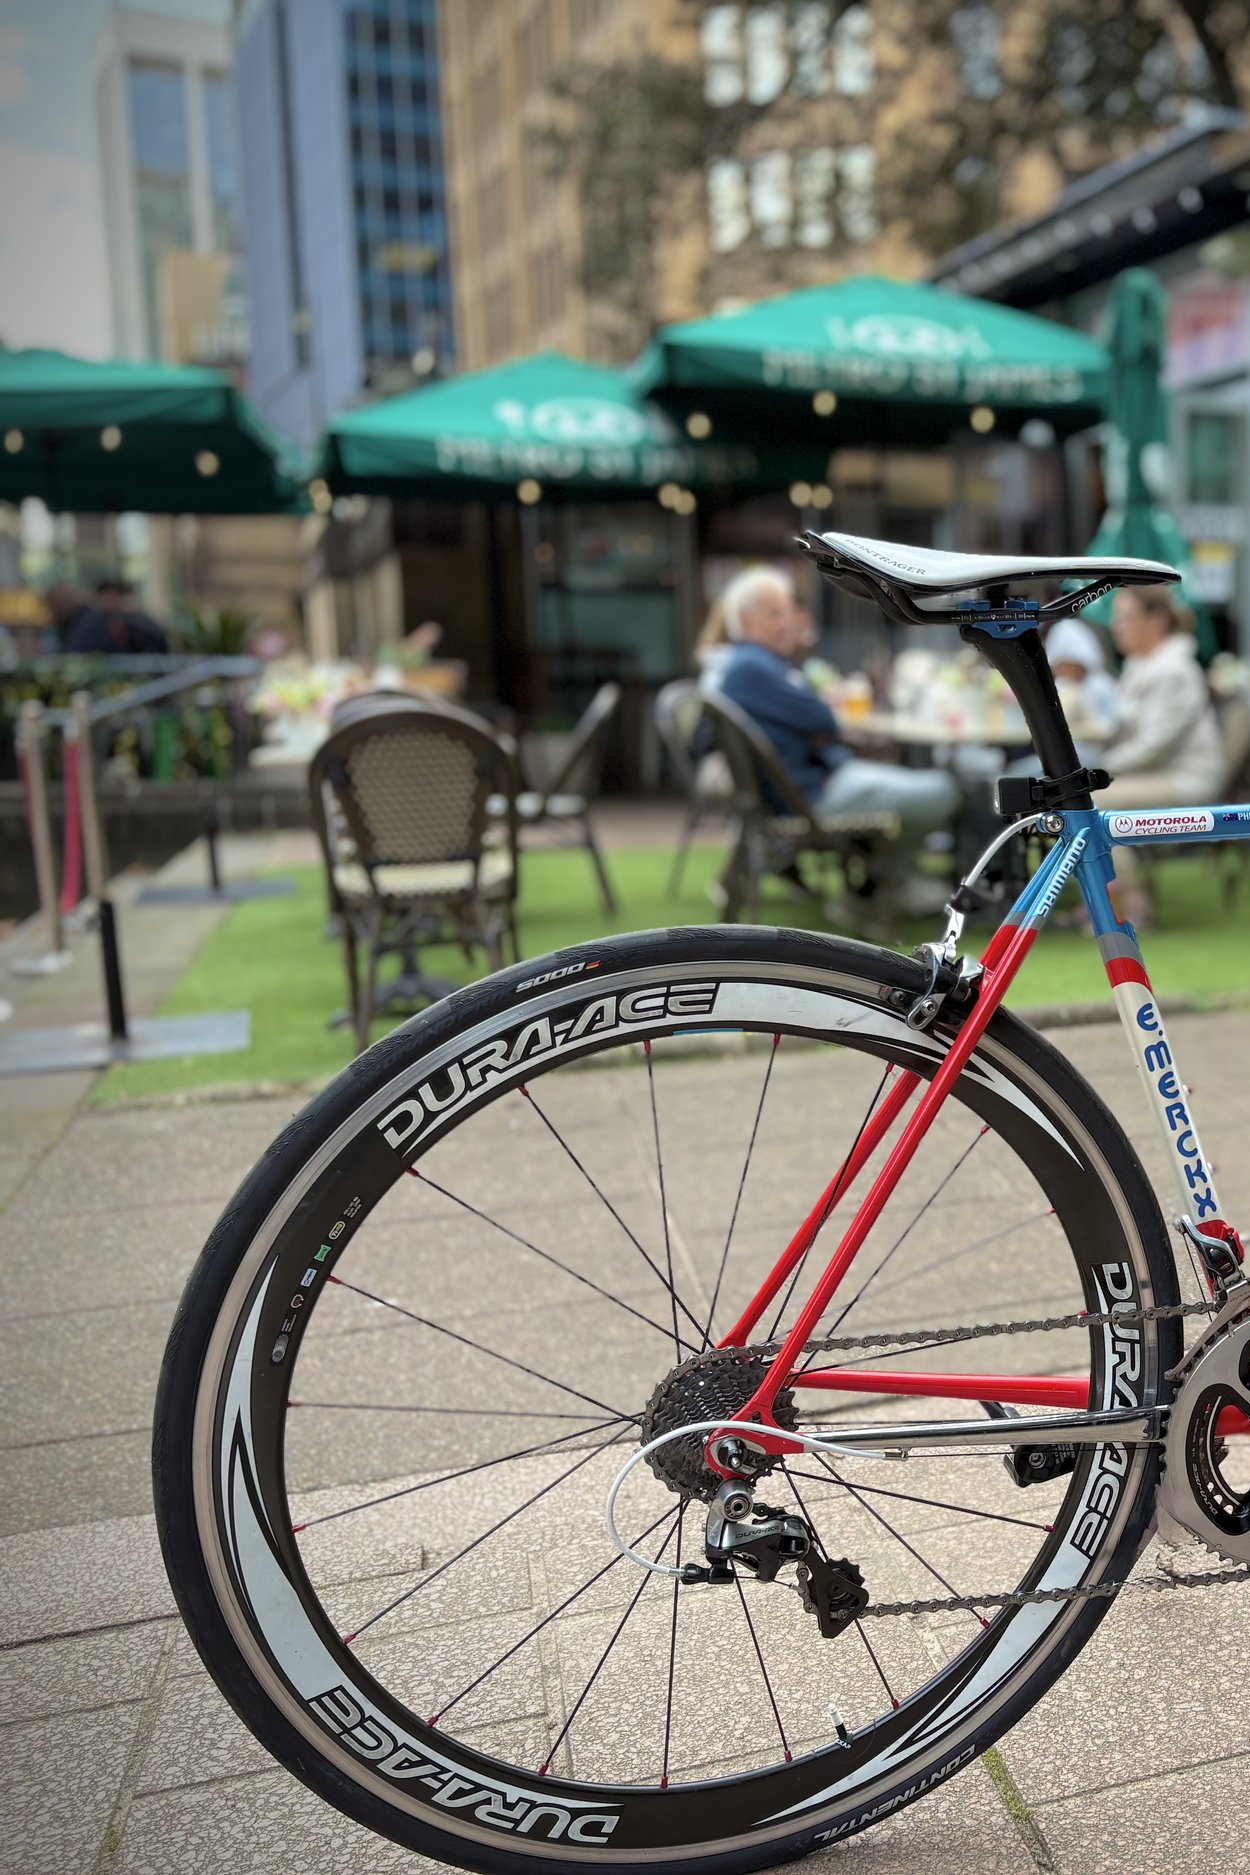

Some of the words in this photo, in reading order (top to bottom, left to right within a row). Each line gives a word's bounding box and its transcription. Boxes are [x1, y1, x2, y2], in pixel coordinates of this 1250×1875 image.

[845, 539, 927, 576] BONTRAGER
[1071, 581, 1113, 614] carbon
[1134, 815, 1208, 827] MOTOROLA
[1134, 826, 1178, 835] CYCLING
[1180, 824, 1207, 833] TEAM
[1035, 837, 1087, 918] SHIMANO
[376, 982, 717, 1150] DURA-ACE
[735, 1525, 780, 1539] DURA-ACE
[308, 1688, 621, 1844] DURA-ACE
[814, 1743, 976, 1843] CONTINENTAL
